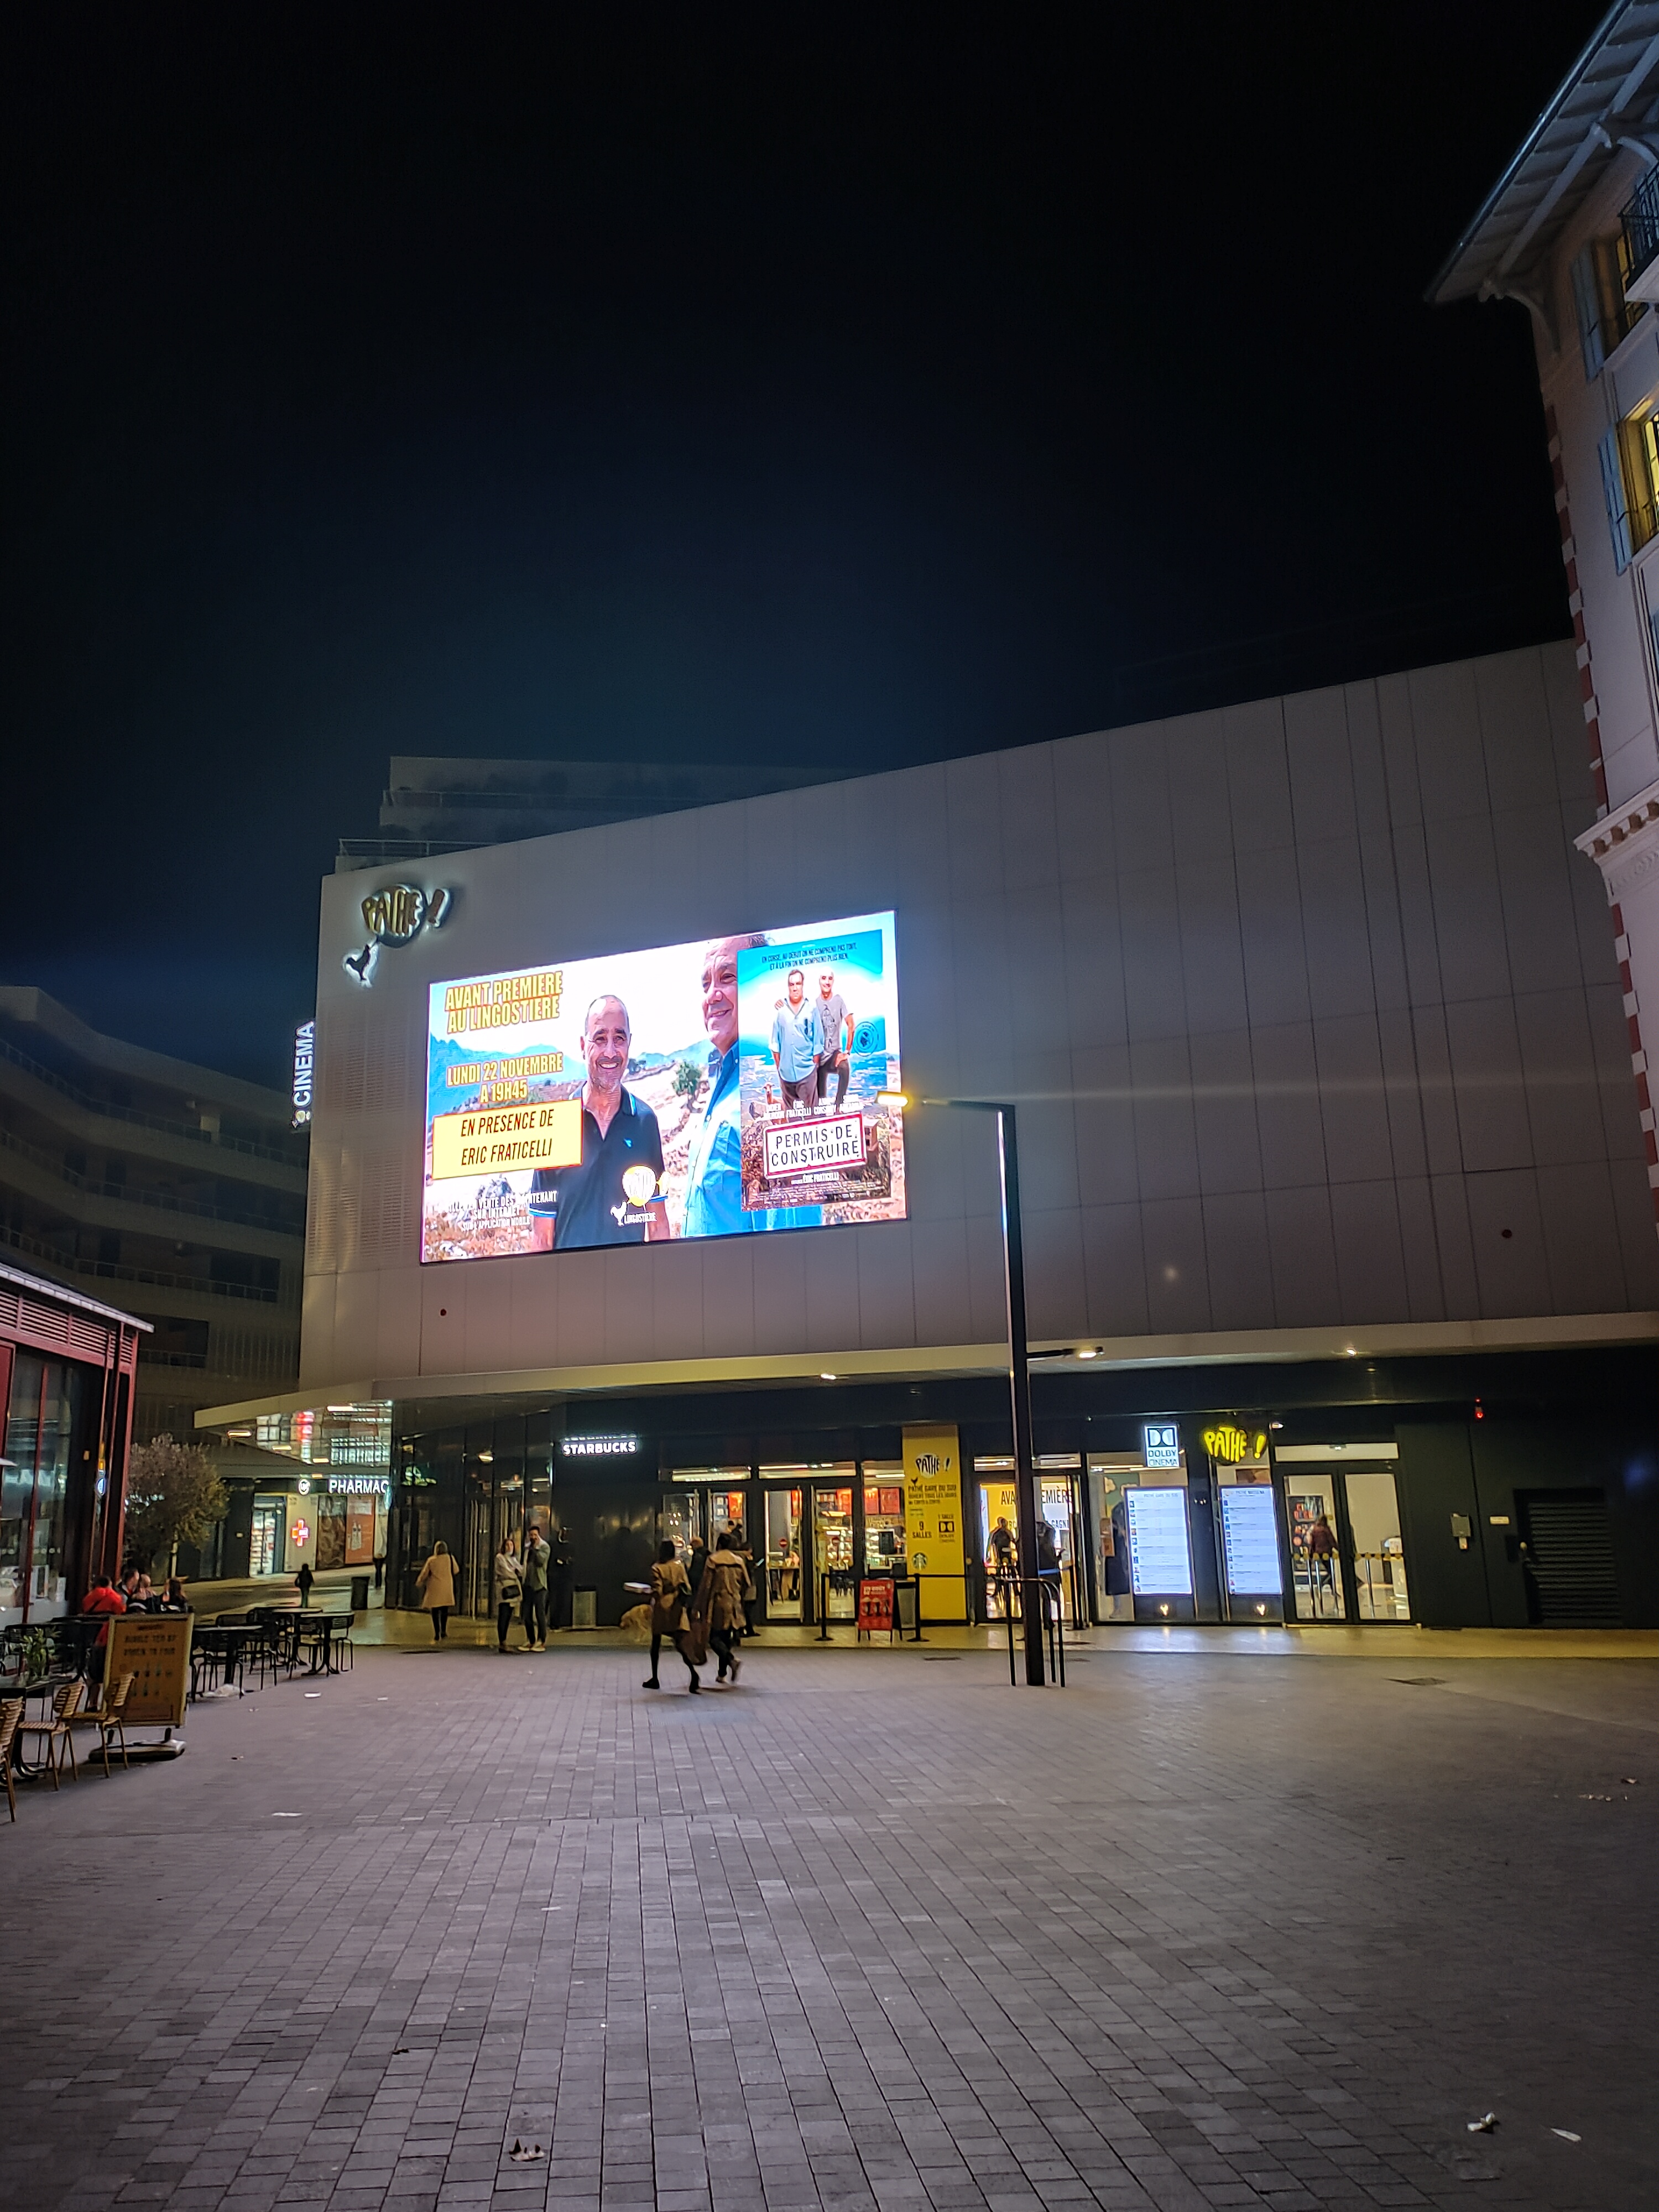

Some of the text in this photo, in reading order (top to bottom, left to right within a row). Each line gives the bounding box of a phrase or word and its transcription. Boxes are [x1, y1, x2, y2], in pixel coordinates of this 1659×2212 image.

[445, 971, 563, 1011] AVANT PREMIERE
[447, 994, 560, 1034] AU LINGOSTIERE
[294, 1021, 314, 1107] CINEMA
[447, 1052, 563, 1087] LUNDI 22 NOVEMBRE
[480, 1079, 528, 1103] A 19H45
[461, 1109, 554, 1137] EN PRESENCE DE
[776, 1125, 852, 1149] PERMIS DE
[461, 1138, 552, 1166] ERIC FRATICELLI
[771, 1140, 859, 1166] CONSTRUIRE
[478, 1197, 499, 1210] VENTE
[563, 1441, 636, 1455] STARBUCKS
[1149, 1449, 1177, 1457] DOLBY
